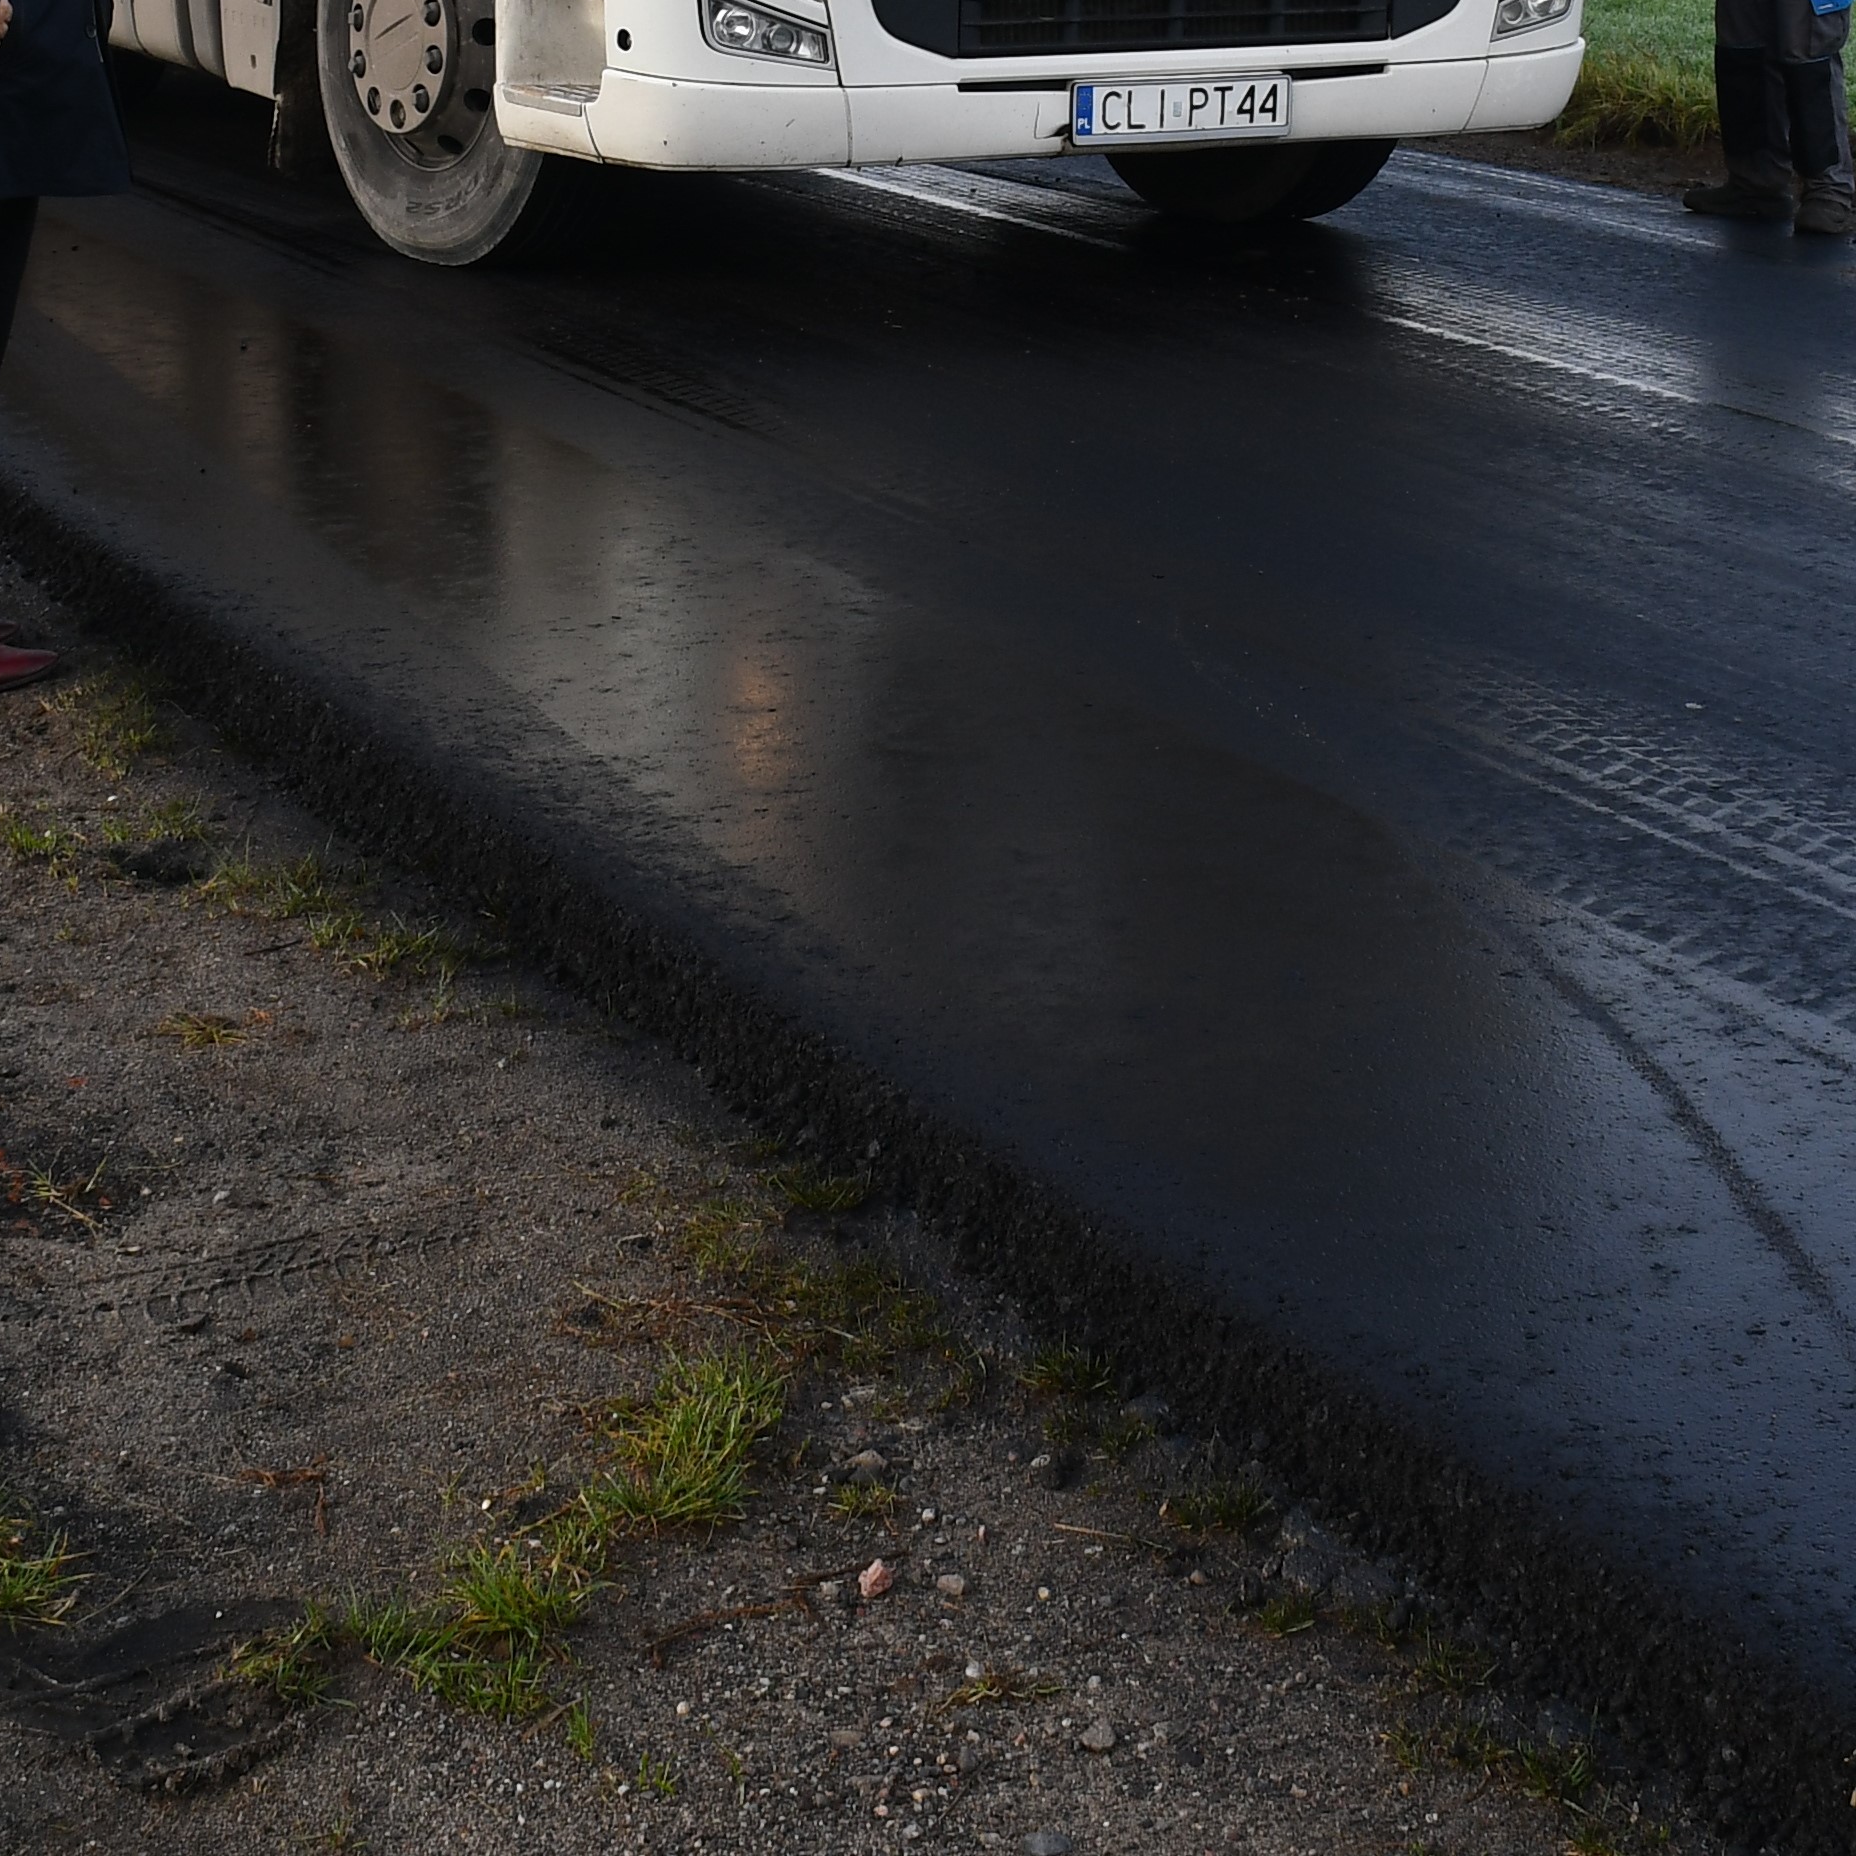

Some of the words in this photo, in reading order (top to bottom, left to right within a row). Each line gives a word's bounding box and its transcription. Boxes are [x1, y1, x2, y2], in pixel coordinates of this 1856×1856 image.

[1077, 118, 1091, 130] PL
[1101, 89, 1166, 130] CLI
[1188, 83, 1279, 127] PT44
